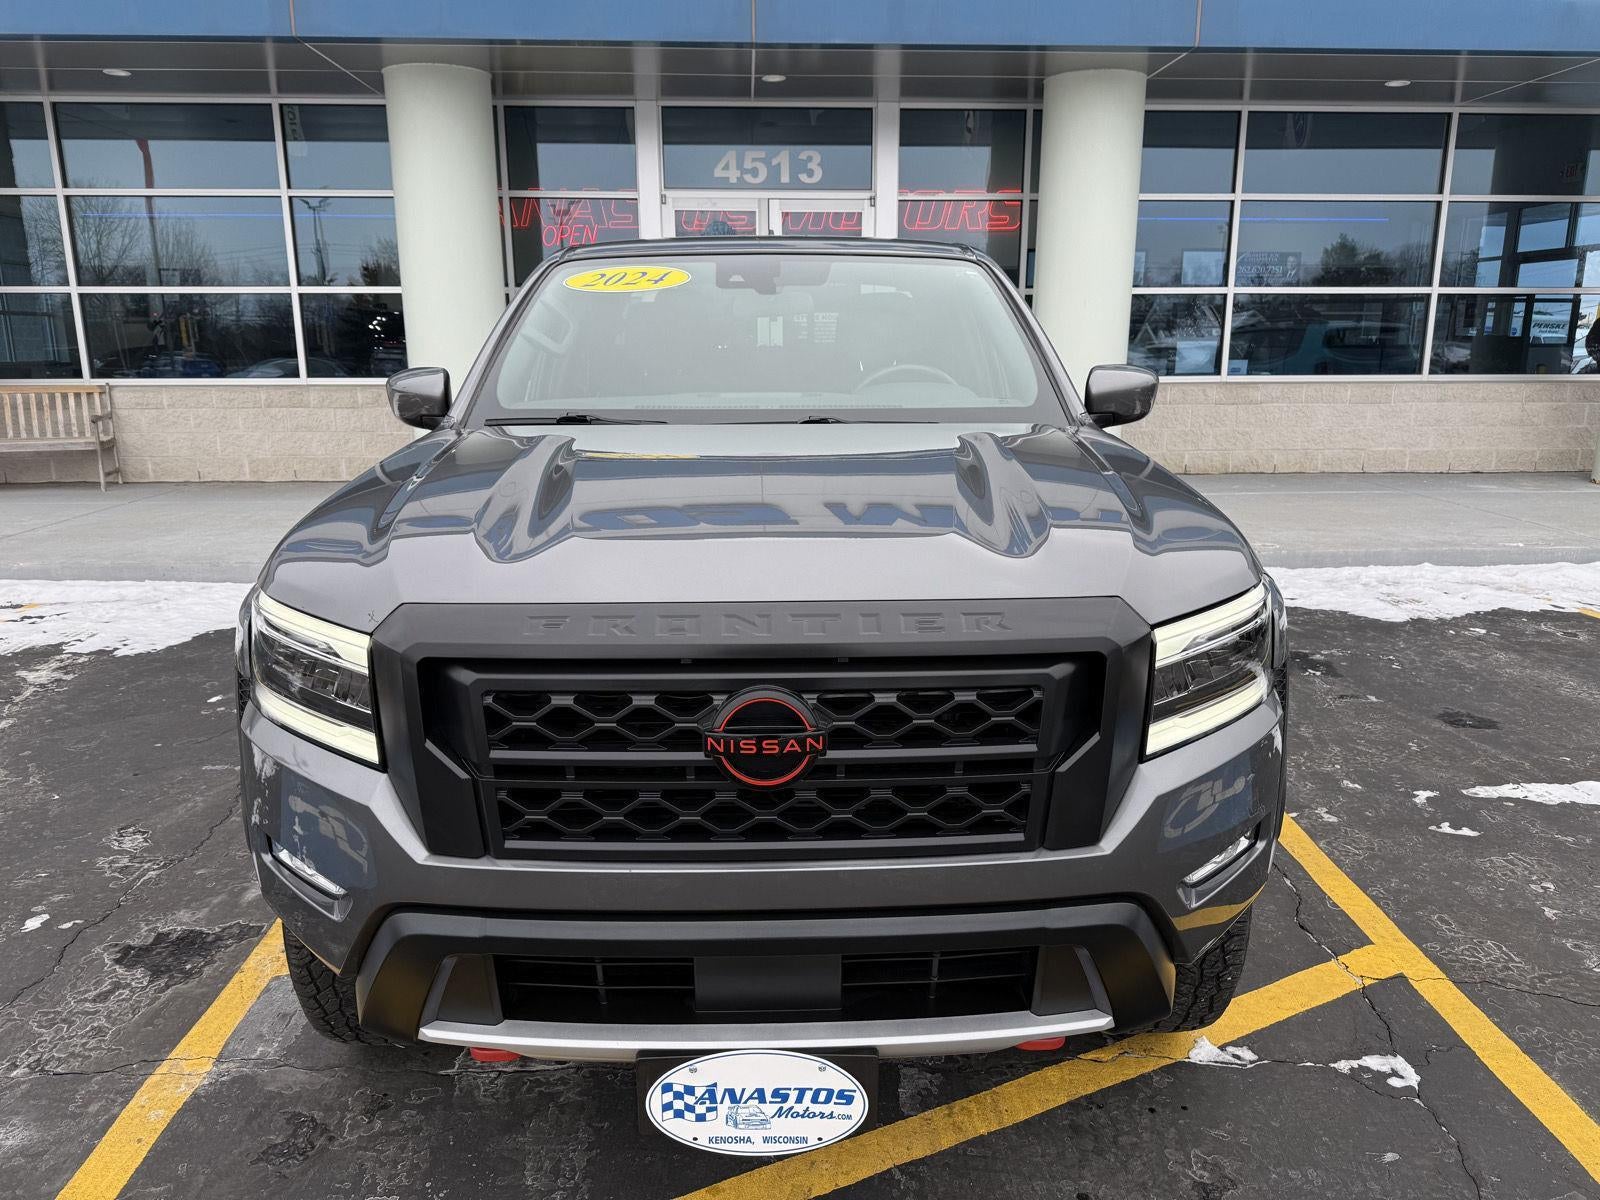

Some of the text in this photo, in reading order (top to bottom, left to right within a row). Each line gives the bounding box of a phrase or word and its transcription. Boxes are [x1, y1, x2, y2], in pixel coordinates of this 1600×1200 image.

[713, 149, 823, 186] 4513
[541, 223, 599, 248] OPEN
[584, 269, 674, 287] 2024
[1532, 322, 1567, 330] PENSKE
[522, 611, 1013, 637] FRONTIER
[706, 734, 824, 755] NISSAN
[694, 1081, 857, 1105] ANASTOS
[707, 1135, 809, 1146] KENOSHA, WISCONSIN
